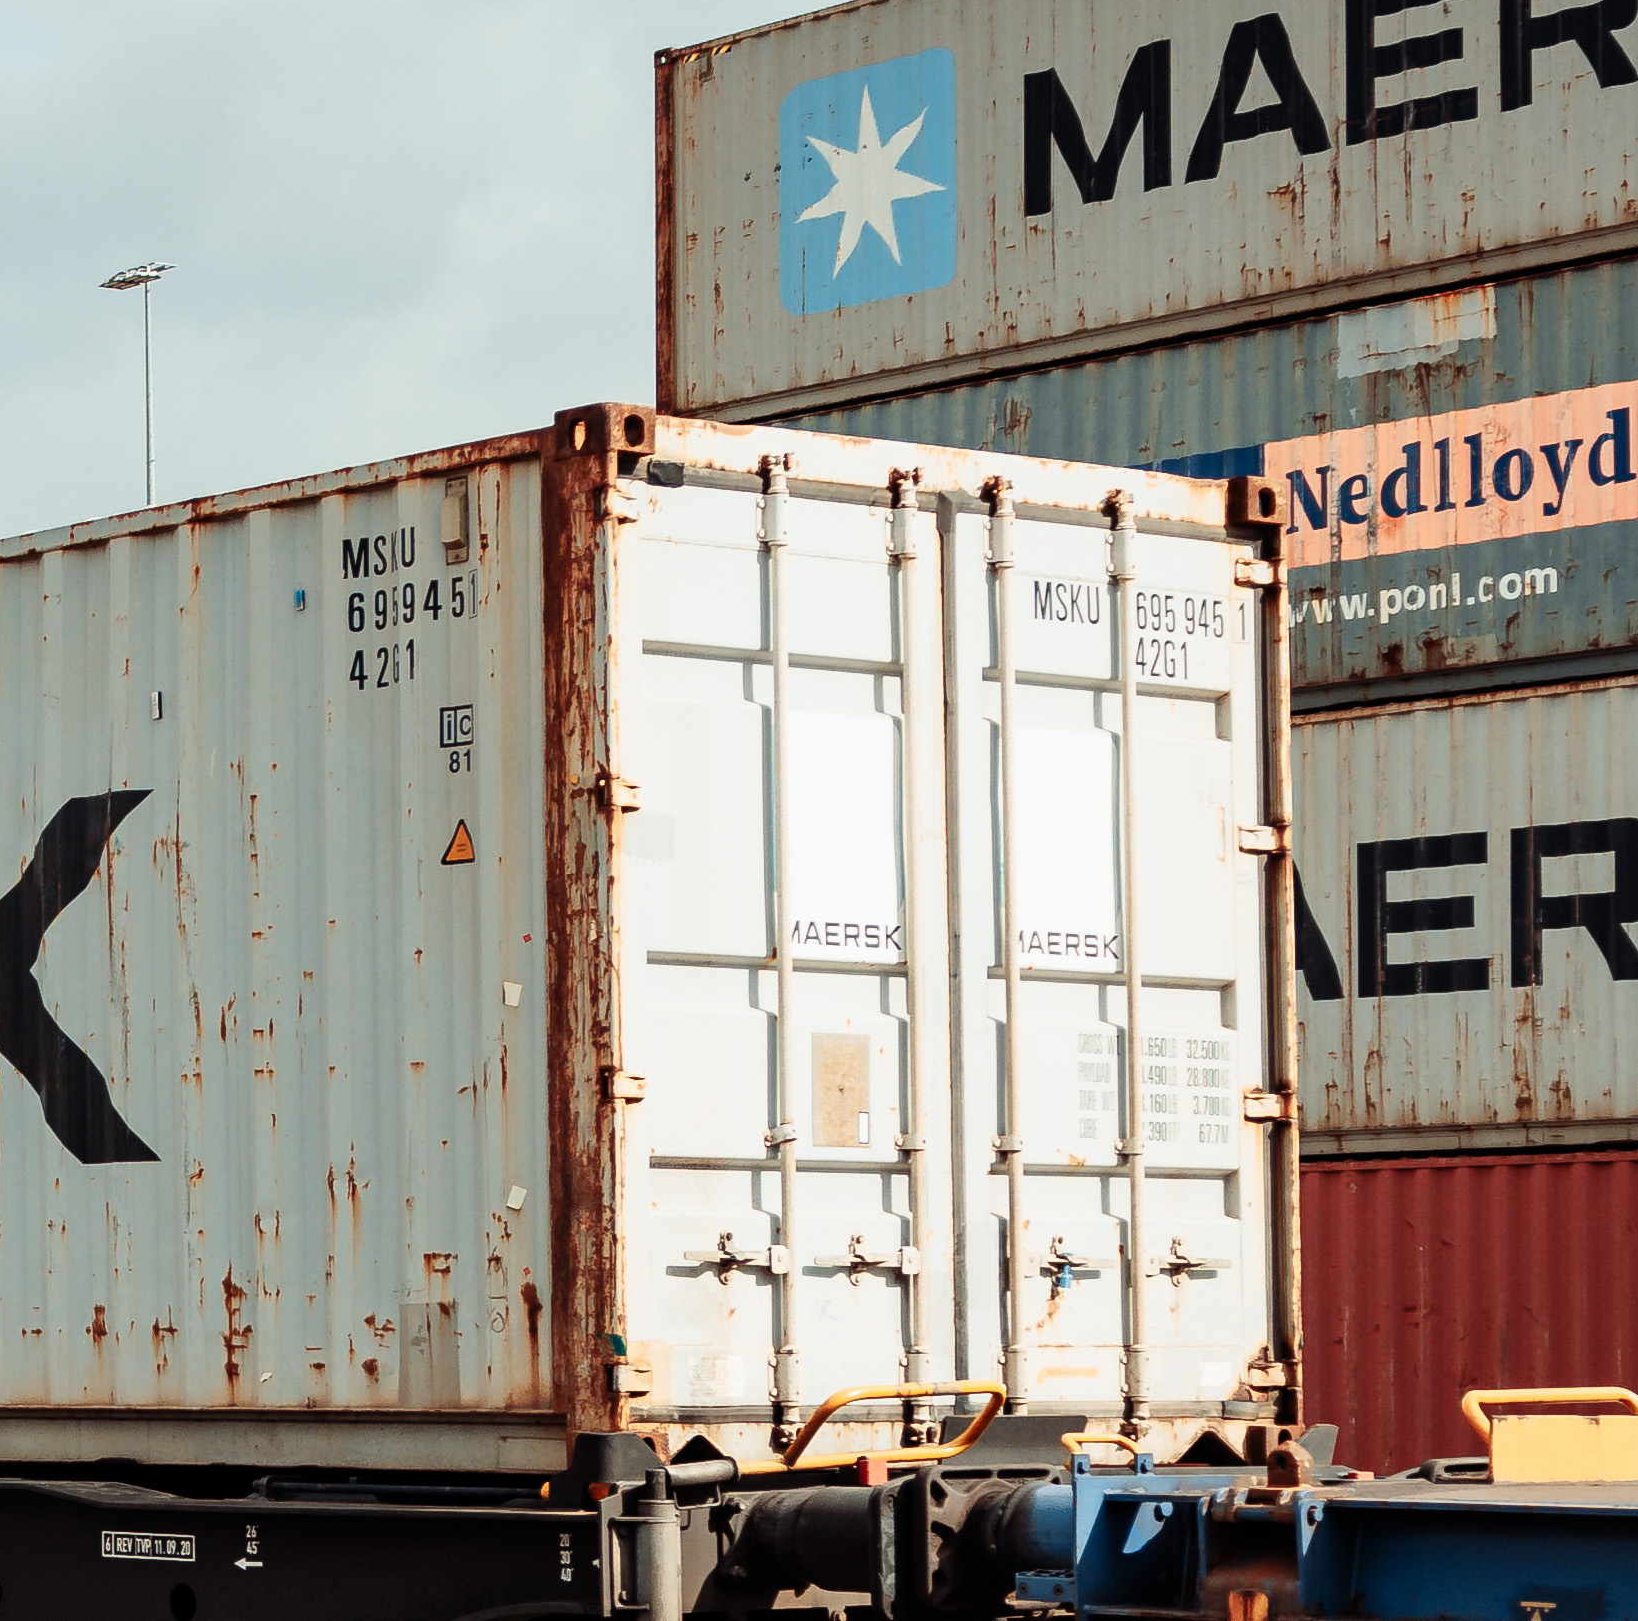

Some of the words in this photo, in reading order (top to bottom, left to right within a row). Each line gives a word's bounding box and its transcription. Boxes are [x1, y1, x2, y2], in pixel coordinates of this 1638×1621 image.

[1286, 407, 1637, 535] Nedlloyd
[342, 527, 416, 580] MSKU
[1034, 580, 1101, 625] MSKU
[1136, 591, 1176, 633] 695
[1184, 597, 1225, 638] 945
[1238, 602, 1246, 641] 1
[349, 638, 416, 690] 42G1
[1135, 637, 1189, 680] 42G1
[449, 748, 472, 773] 81
[116, 1538, 133, 1553] REV
[154, 1539, 191, 1556] 11.09.20
